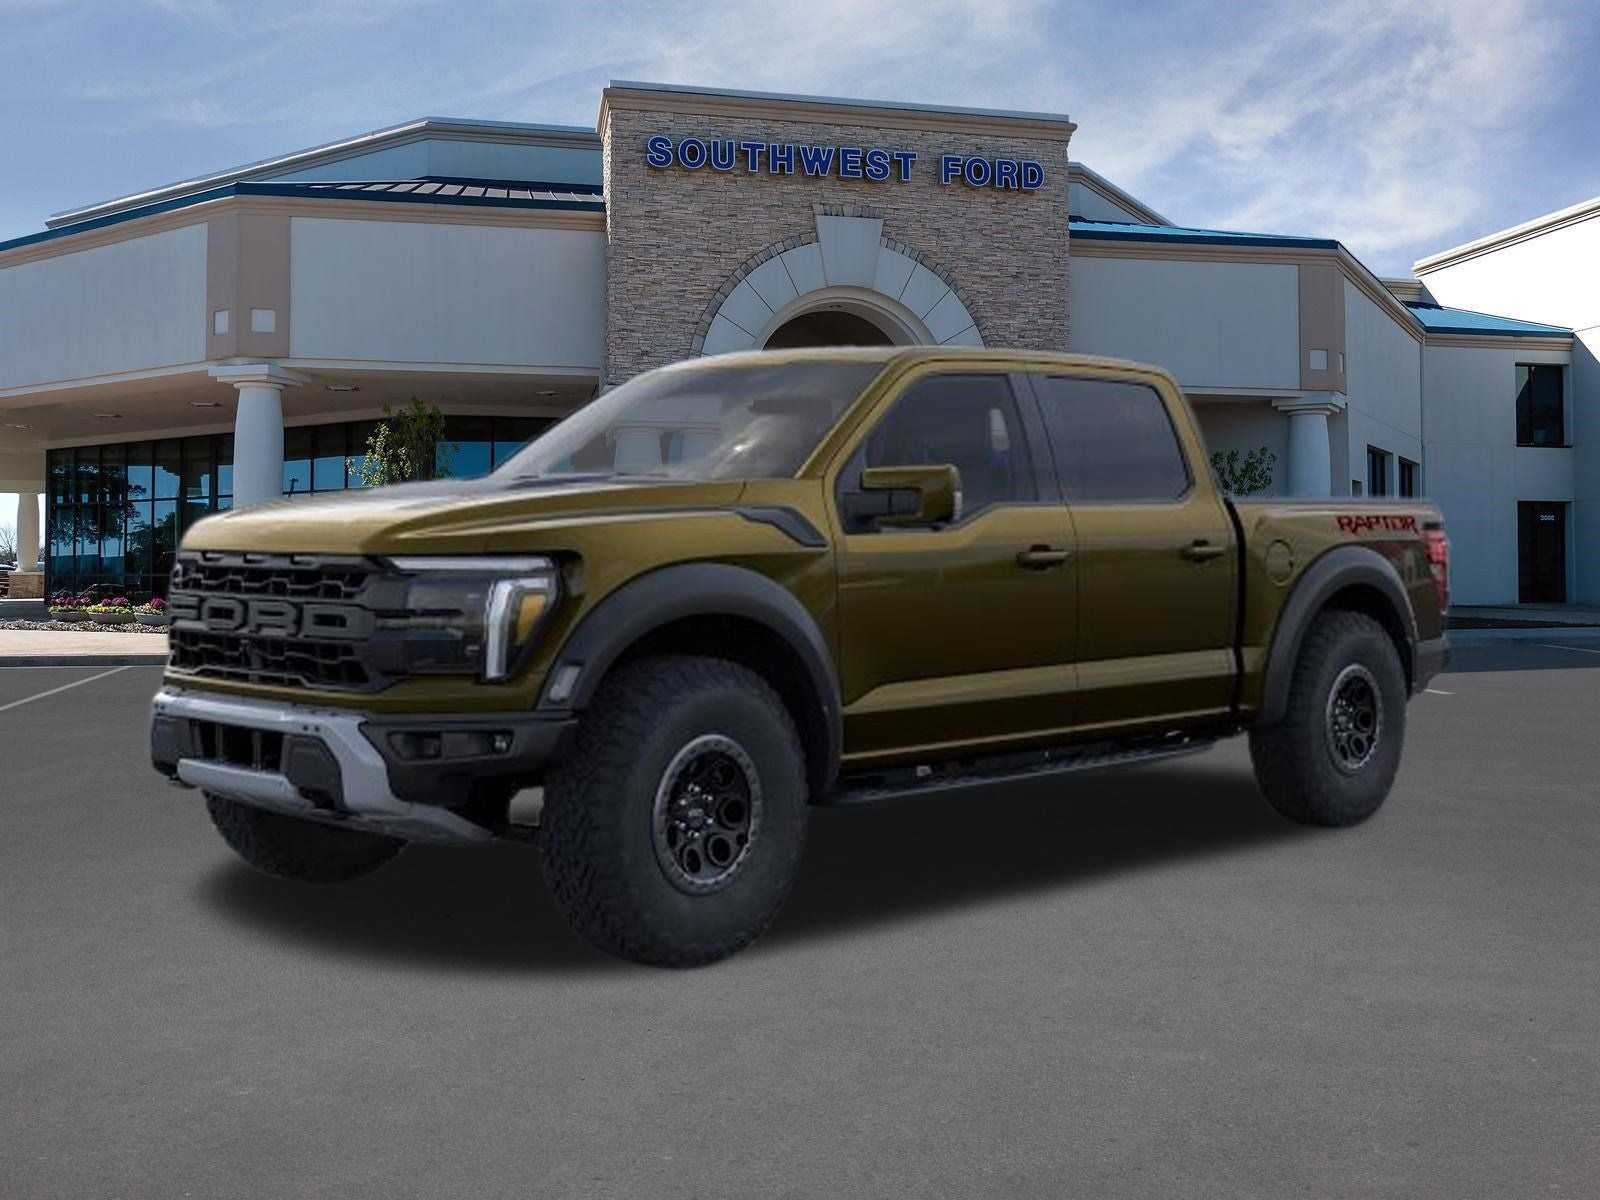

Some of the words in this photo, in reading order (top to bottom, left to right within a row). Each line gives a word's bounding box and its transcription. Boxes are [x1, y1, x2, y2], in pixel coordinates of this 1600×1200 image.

[646, 135, 917, 182] SOUTHWEST
[940, 154, 1046, 191] FORD
[1336, 515, 1419, 535] RAPTOR
[170, 593, 376, 640] FORD
